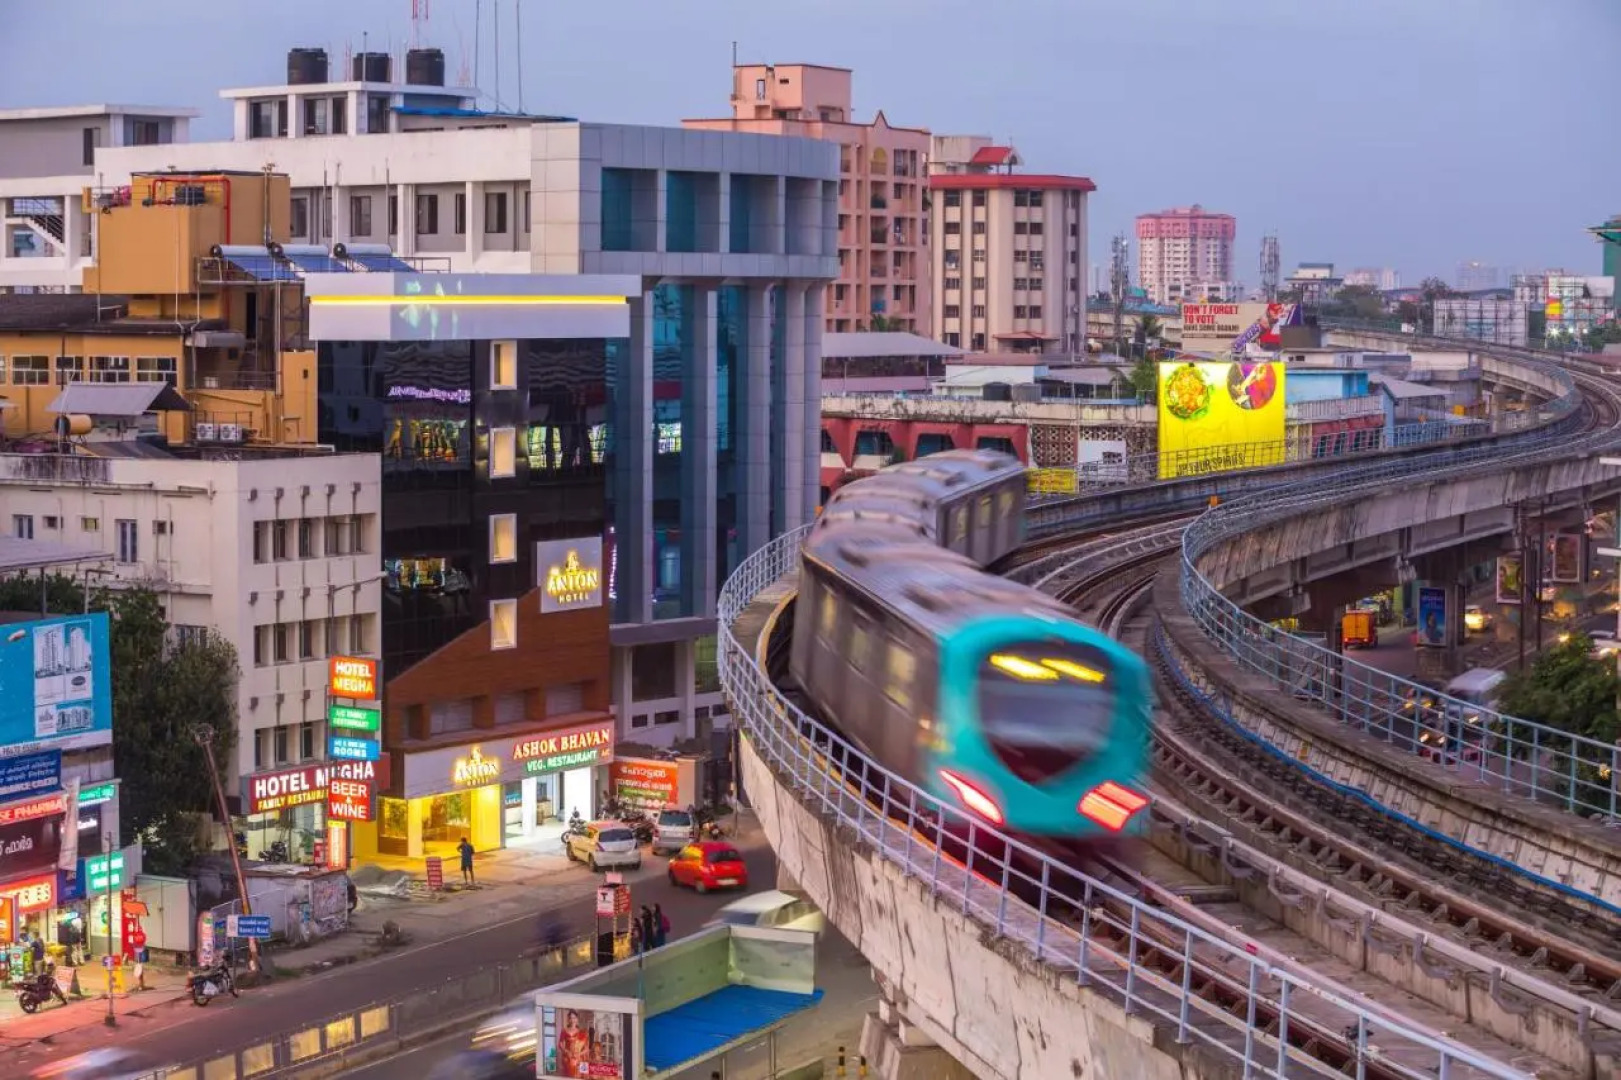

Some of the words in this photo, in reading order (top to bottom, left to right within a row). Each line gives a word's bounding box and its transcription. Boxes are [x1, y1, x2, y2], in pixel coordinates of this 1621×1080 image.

[1183, 304, 1207, 315] DON'T
[1209, 304, 1239, 315] FORGET
[1184, 314, 1194, 324] TO
[559, 592, 590, 604] HOTEL
[335, 661, 372, 677] HOTEL
[333, 676, 374, 694] MEGHA
[333, 746, 367, 758] ROOMS
[513, 737, 558, 760] ASHOK
[560, 729, 611, 751] BHAVAN
[526, 760, 546, 772] VEG.
[547, 749, 598, 768] RESTAURANT
[255, 771, 310, 799] HOTEL
[331, 780, 368, 798] BEER
[257, 796, 286, 811] FAMILY
[345, 795, 353, 804] &
[14, 798, 63, 819] PHARMA
[331, 802, 367, 819] WINE
